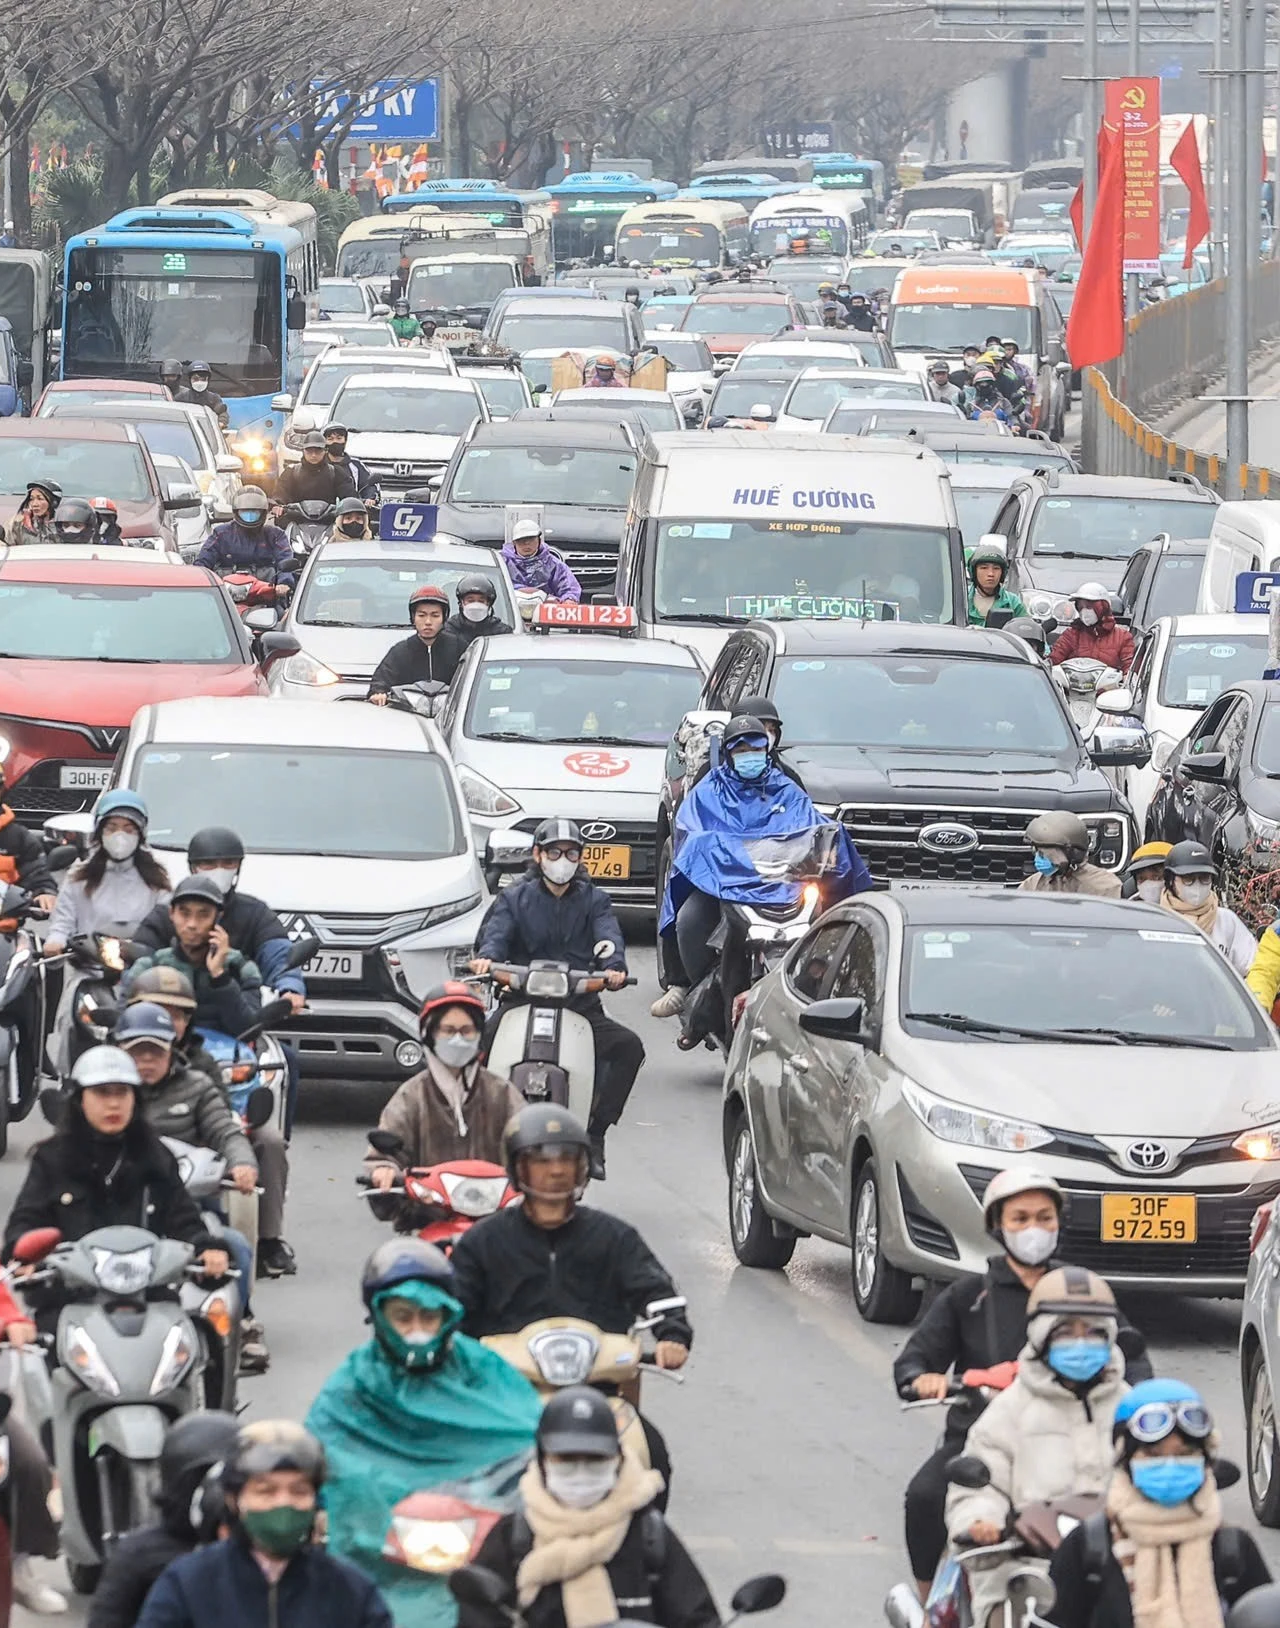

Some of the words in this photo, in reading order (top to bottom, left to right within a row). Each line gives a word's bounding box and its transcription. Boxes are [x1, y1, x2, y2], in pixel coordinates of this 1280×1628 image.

[732, 483, 783, 506] HUẾ
[792, 487, 876, 510] CƯỜNG
[393, 507, 424, 537] G7
[543, 603, 582, 621] Taxi
[935, 831, 965, 845] Ford
[583, 846, 612, 861] 30F
[1130, 1197, 1169, 1216] 30F
[1113, 1219, 1185, 1239] 972.59
